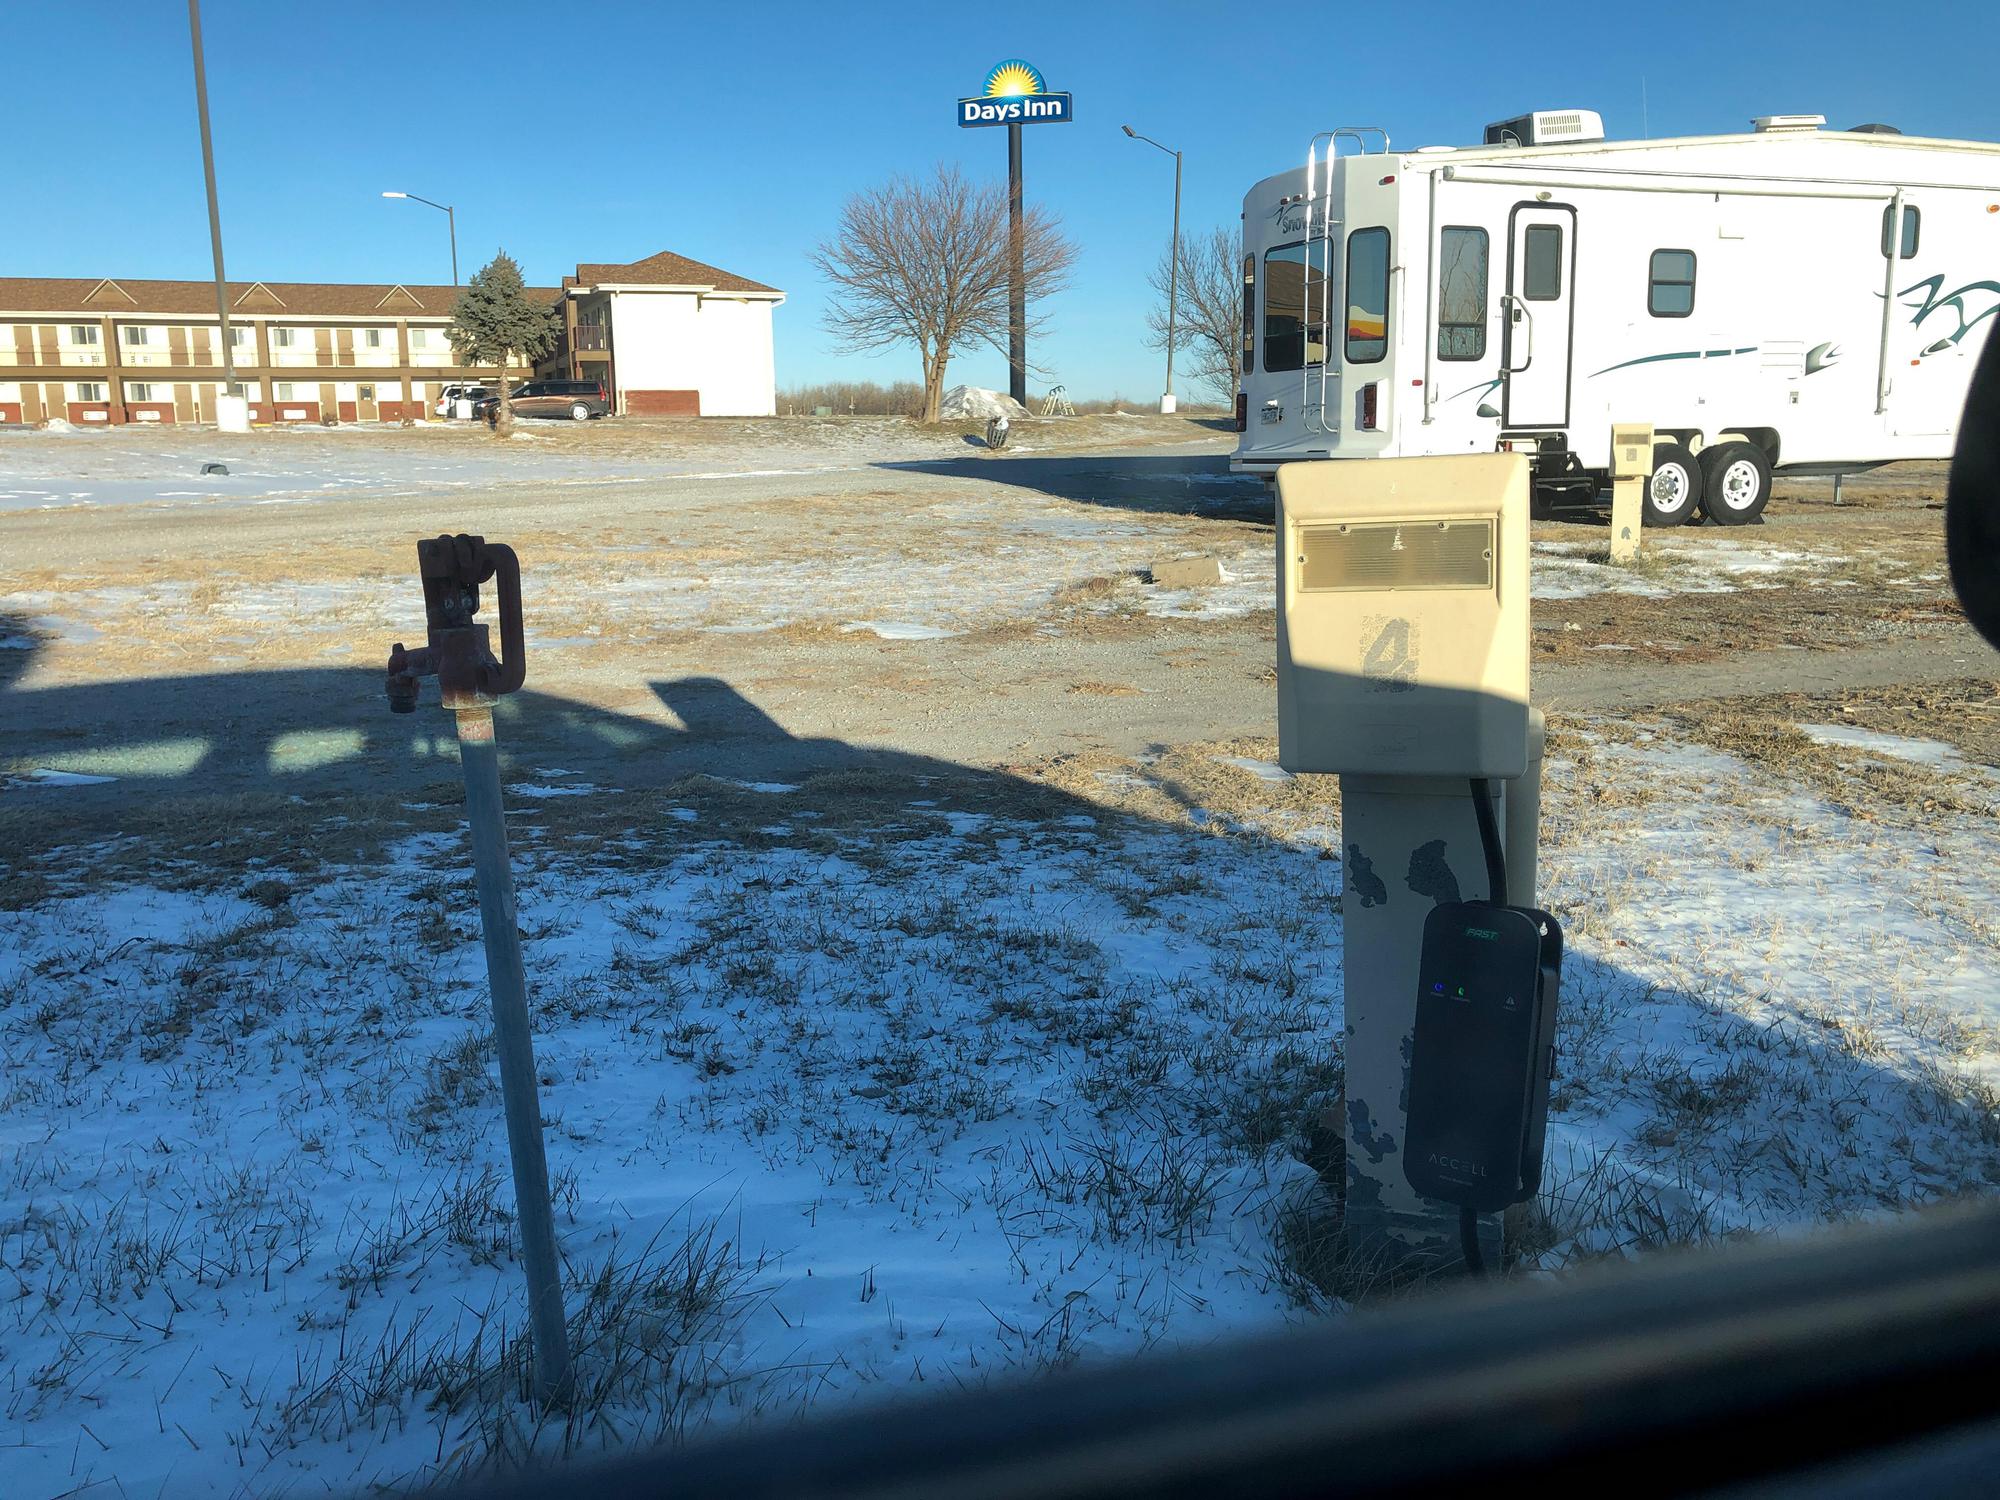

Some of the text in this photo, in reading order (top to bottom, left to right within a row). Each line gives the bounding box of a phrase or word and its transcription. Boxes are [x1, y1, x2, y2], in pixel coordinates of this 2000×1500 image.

[965, 99, 1062, 121] Days Inn
[1363, 617, 1419, 693] 4
[1466, 928, 1498, 941] FAST
[1428, 1153, 1488, 1177] ACCELL
